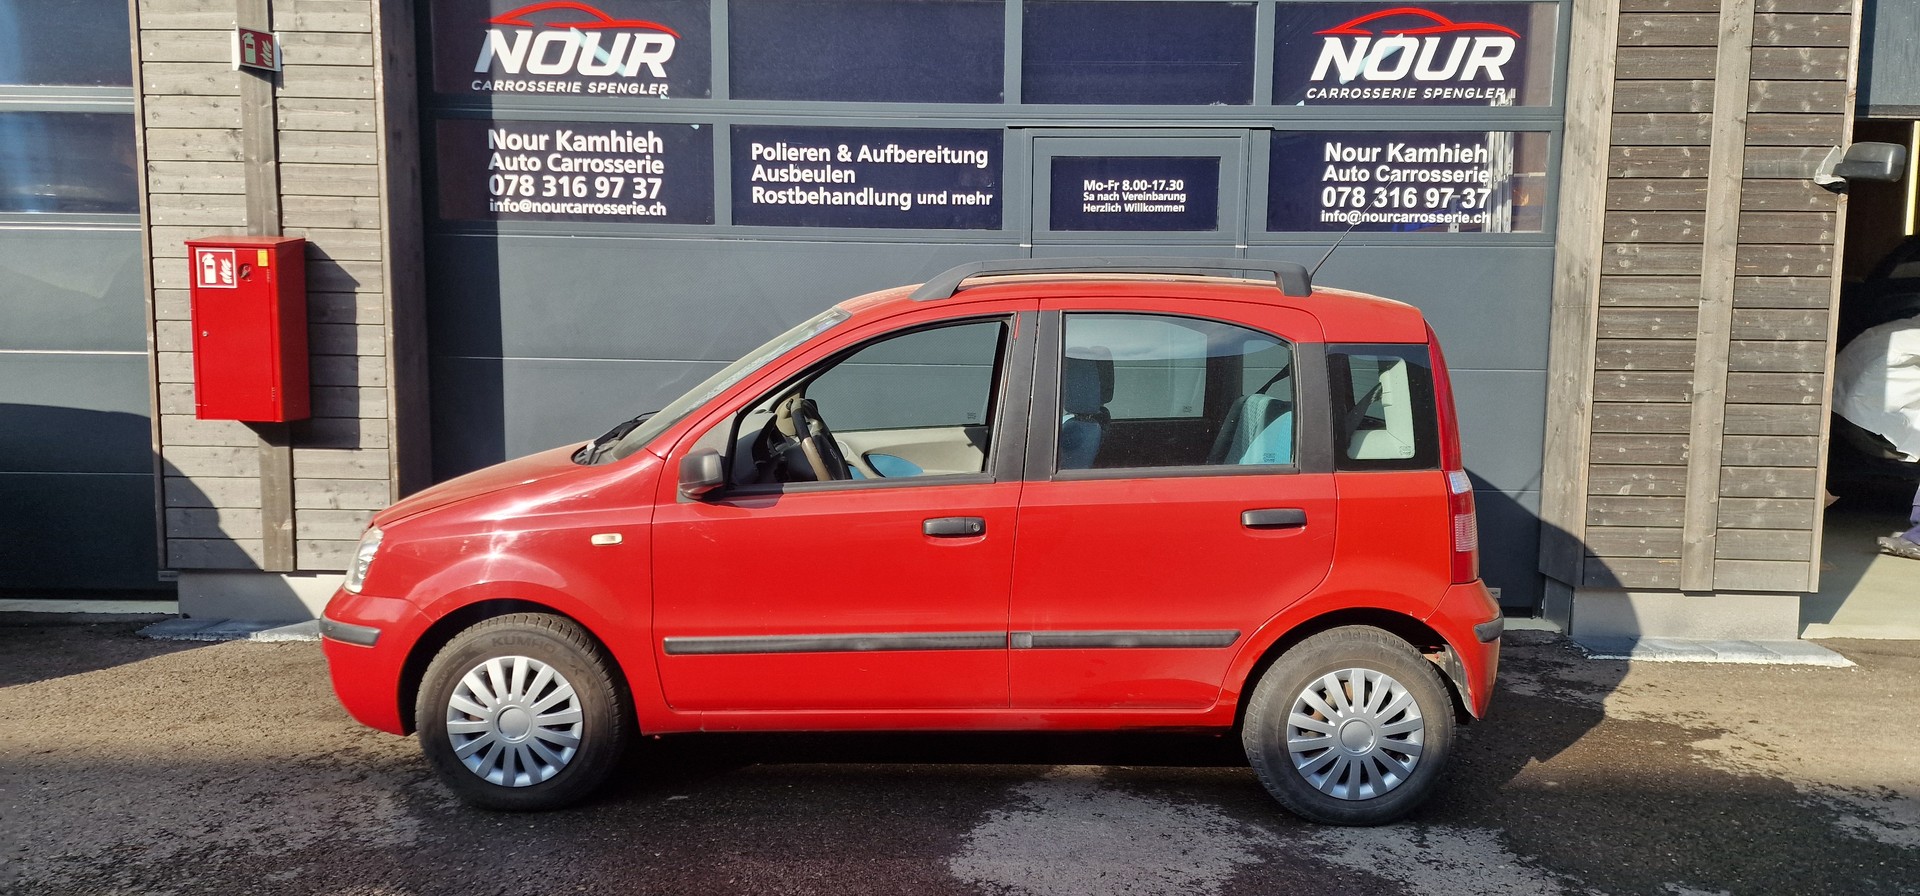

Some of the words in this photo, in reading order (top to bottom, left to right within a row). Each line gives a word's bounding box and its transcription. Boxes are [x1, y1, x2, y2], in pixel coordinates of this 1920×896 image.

[474, 29, 676, 78] NOUR
[1310, 36, 1516, 81] NOUR
[471, 80, 582, 93] CARROSSERIE
[587, 83, 669, 95] SPENGLER
[1306, 87, 1417, 99] CARROSSERIE
[1423, 88, 1505, 99] SPENGLER
[488, 129, 550, 151] Nour
[556, 130, 663, 154] Kamhieh
[751, 142, 831, 163] Polieren
[837, 144, 852, 163] &
[857, 144, 988, 168] Aufbereitung
[1325, 142, 1381, 162] Nour
[1387, 143, 1488, 163] Kamhieh
[488, 152, 541, 171] Auto
[547, 153, 664, 174] Carrosserie
[751, 164, 856, 183] Ausbeulen
[1322, 164, 1370, 182] Auto
[1376, 165, 1490, 183] Carrosserie
[489, 174, 535, 196] 078
[542, 175, 587, 197] 316
[595, 176, 625, 198] 97
[632, 177, 662, 200] 37
[1083, 179, 1120, 191] Mo-Fr
[1122, 179, 1184, 191] 8.00-17.30
[489, 198, 667, 216] info@nourcarrosserie.ch
[752, 186, 912, 210] Rostbehandlung
[917, 191, 947, 205] und
[952, 191, 993, 206] mehr
[1083, 192, 1095, 201] Sa
[1097, 192, 1120, 201] nach
[1122, 192, 1186, 203] Vereinbarung
[1322, 186, 1366, 208] 078
[1373, 187, 1418, 208] 316
[1425, 187, 1454, 209] 97
[1461, 188, 1491, 209] 37
[1083, 203, 1121, 212] Herzlich
[1124, 203, 1185, 212] Willkommen
[1321, 209, 1490, 225] info@nourcarrosserie.ch
[492, 636, 557, 653] KUMHO
